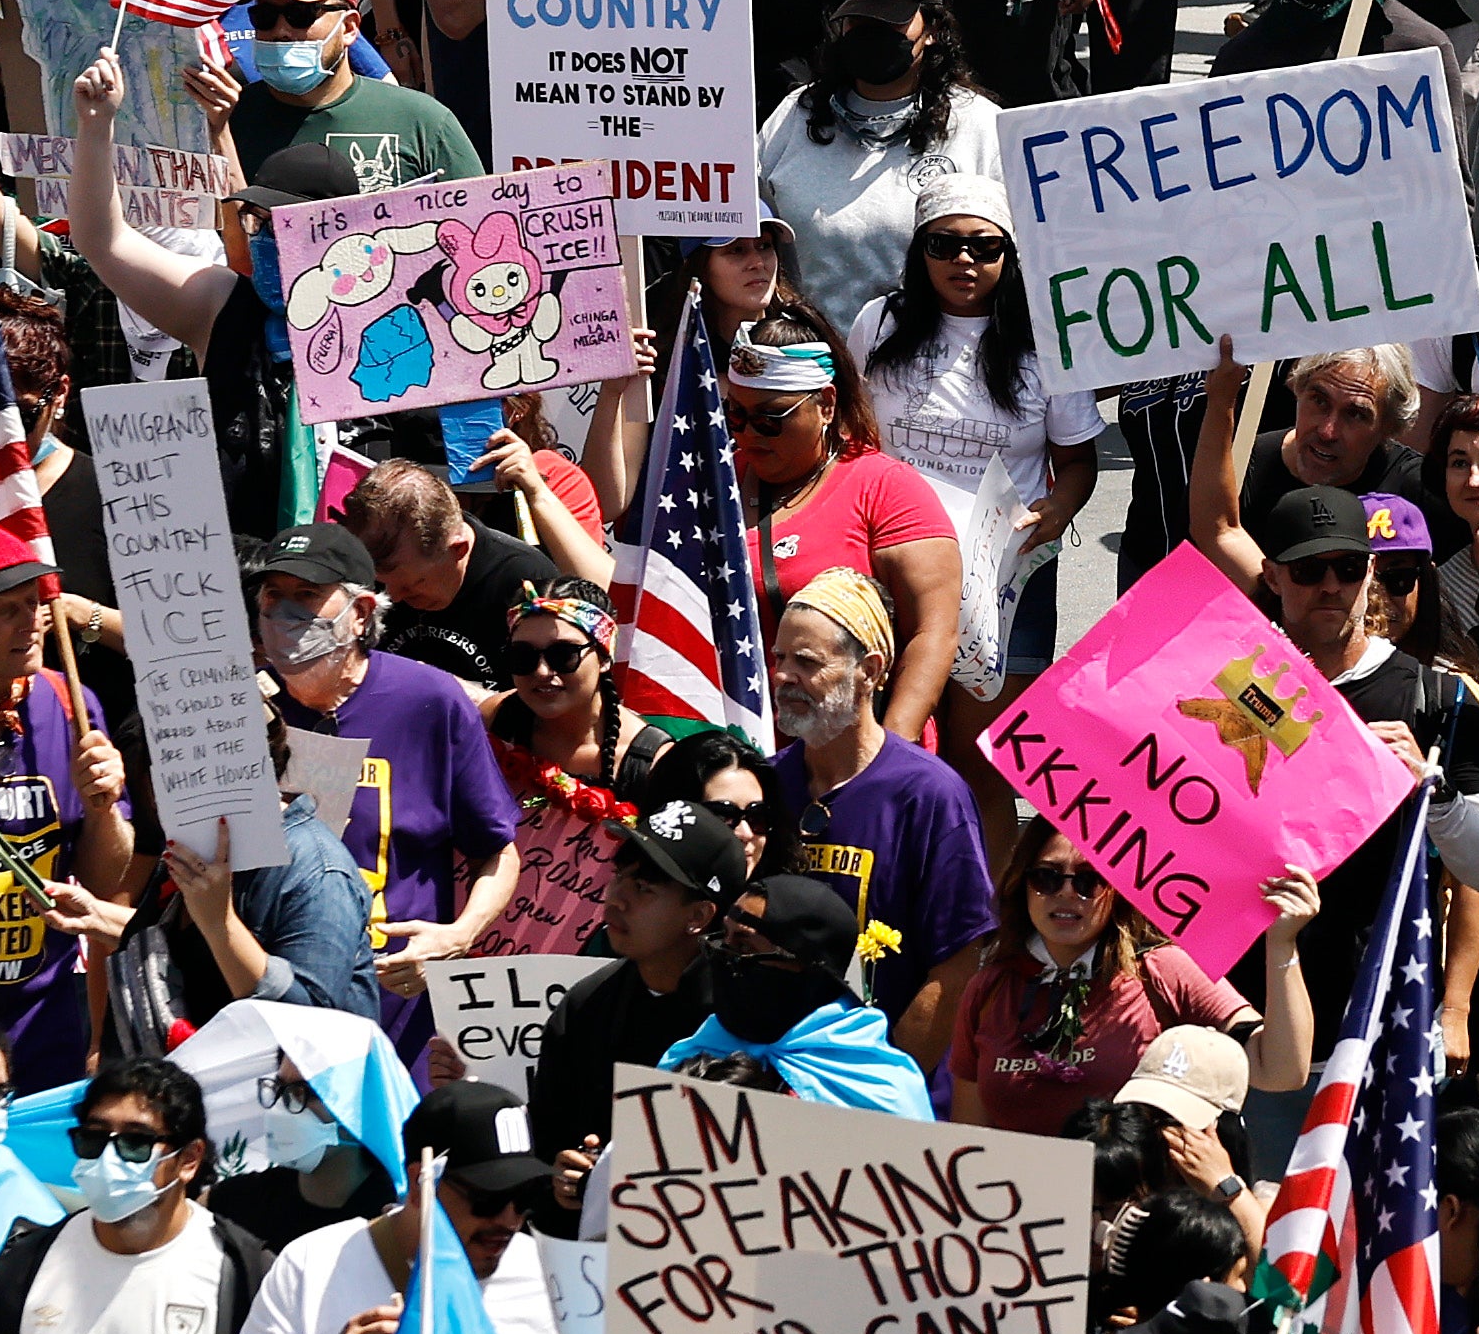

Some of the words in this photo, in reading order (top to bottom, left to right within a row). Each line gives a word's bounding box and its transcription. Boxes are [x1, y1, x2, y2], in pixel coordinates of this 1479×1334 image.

[1020, 75, 1442, 223] FREEDOM
[1049, 256, 1215, 369] FOR
[1260, 221, 1434, 333] ALL
[991, 709, 1211, 937] KKKING
[1121, 733, 1221, 826] NO
[616, 1085, 767, 1179] I'M
[610, 1147, 1020, 1255] SPEAKING
[841, 1220, 1086, 1305] THOSE
